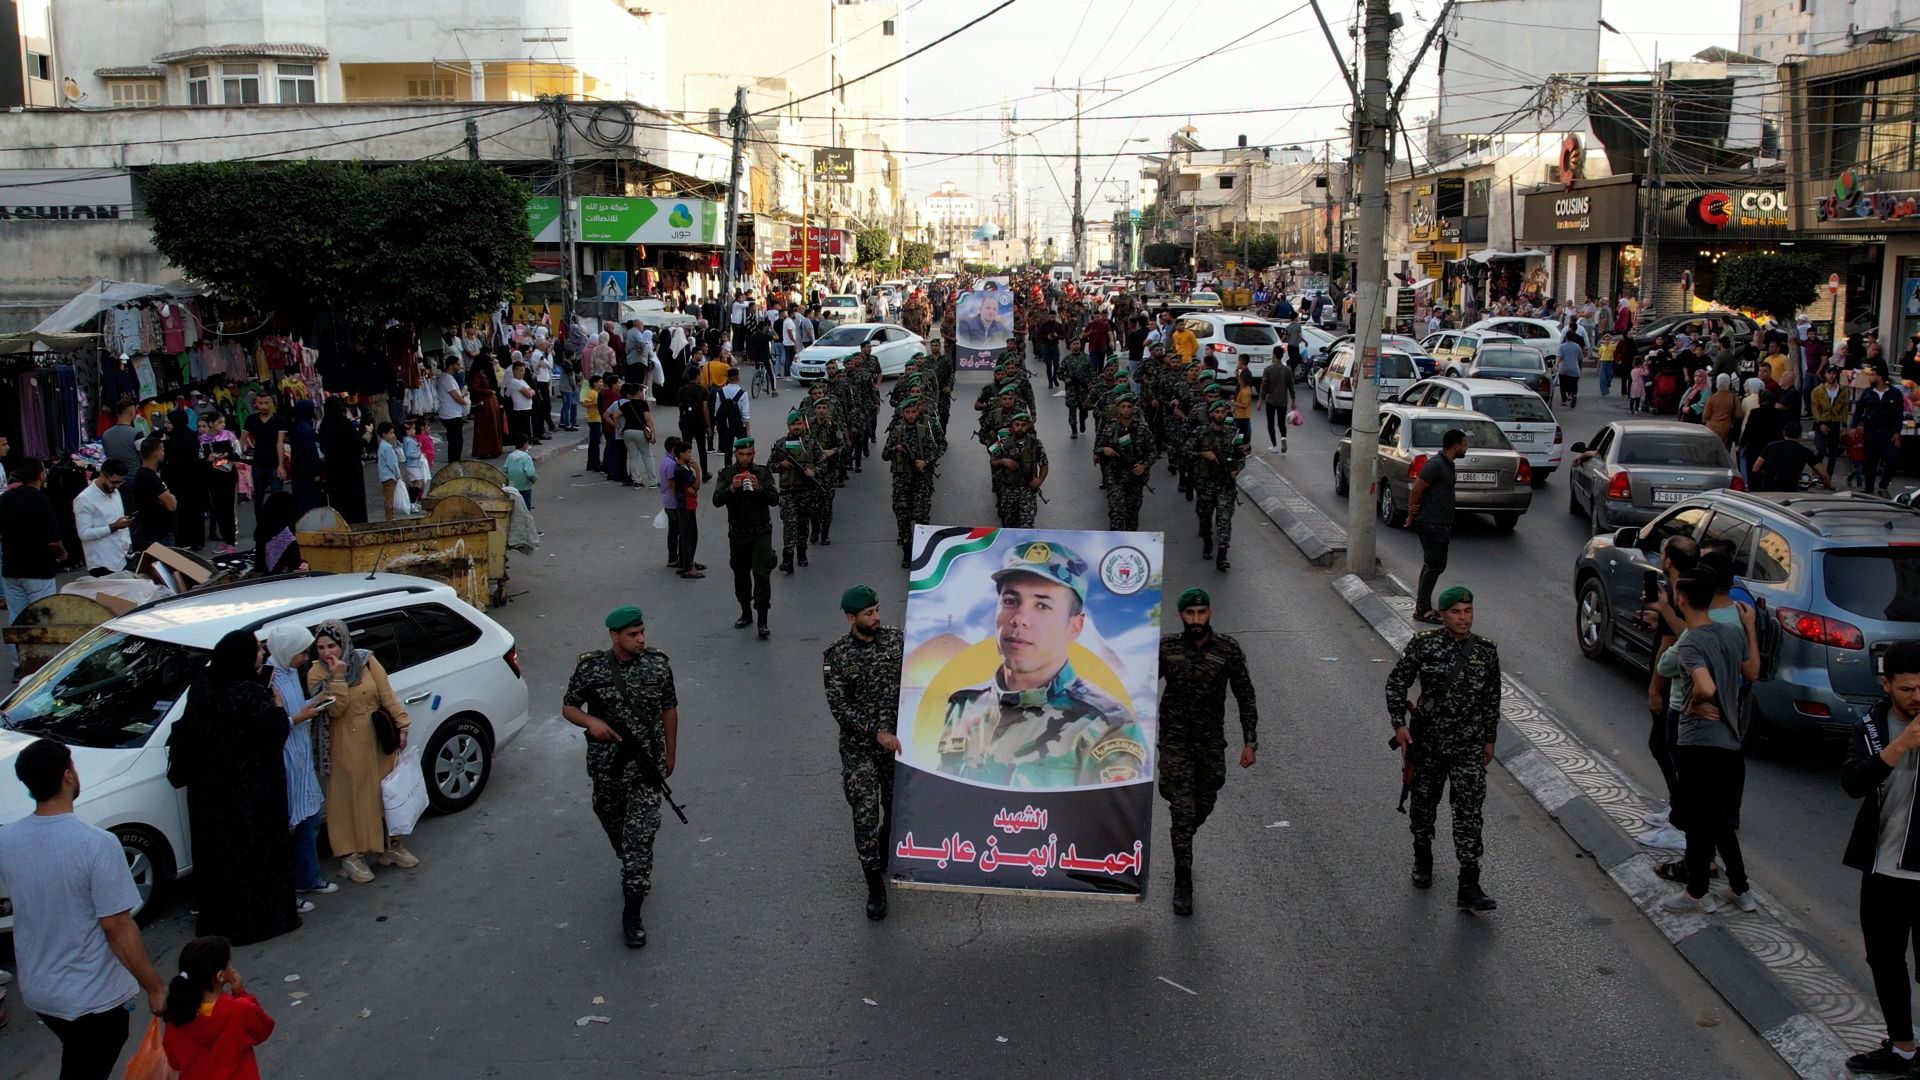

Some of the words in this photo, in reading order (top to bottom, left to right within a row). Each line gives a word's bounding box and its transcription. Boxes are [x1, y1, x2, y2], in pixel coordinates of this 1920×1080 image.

[610, 202, 629, 212] شركة
[1555, 196, 1589, 216] COUSINS
[585, 214, 618, 223] للاتصالات
[1741, 217, 1758, 225] Bar
[671, 231, 691, 240] جوال
[994, 805, 1048, 833] الشهيد
[896, 831, 977, 868] عابد
[979, 833, 1057, 876] أيمن
[1059, 840, 1143, 875] أحمد
